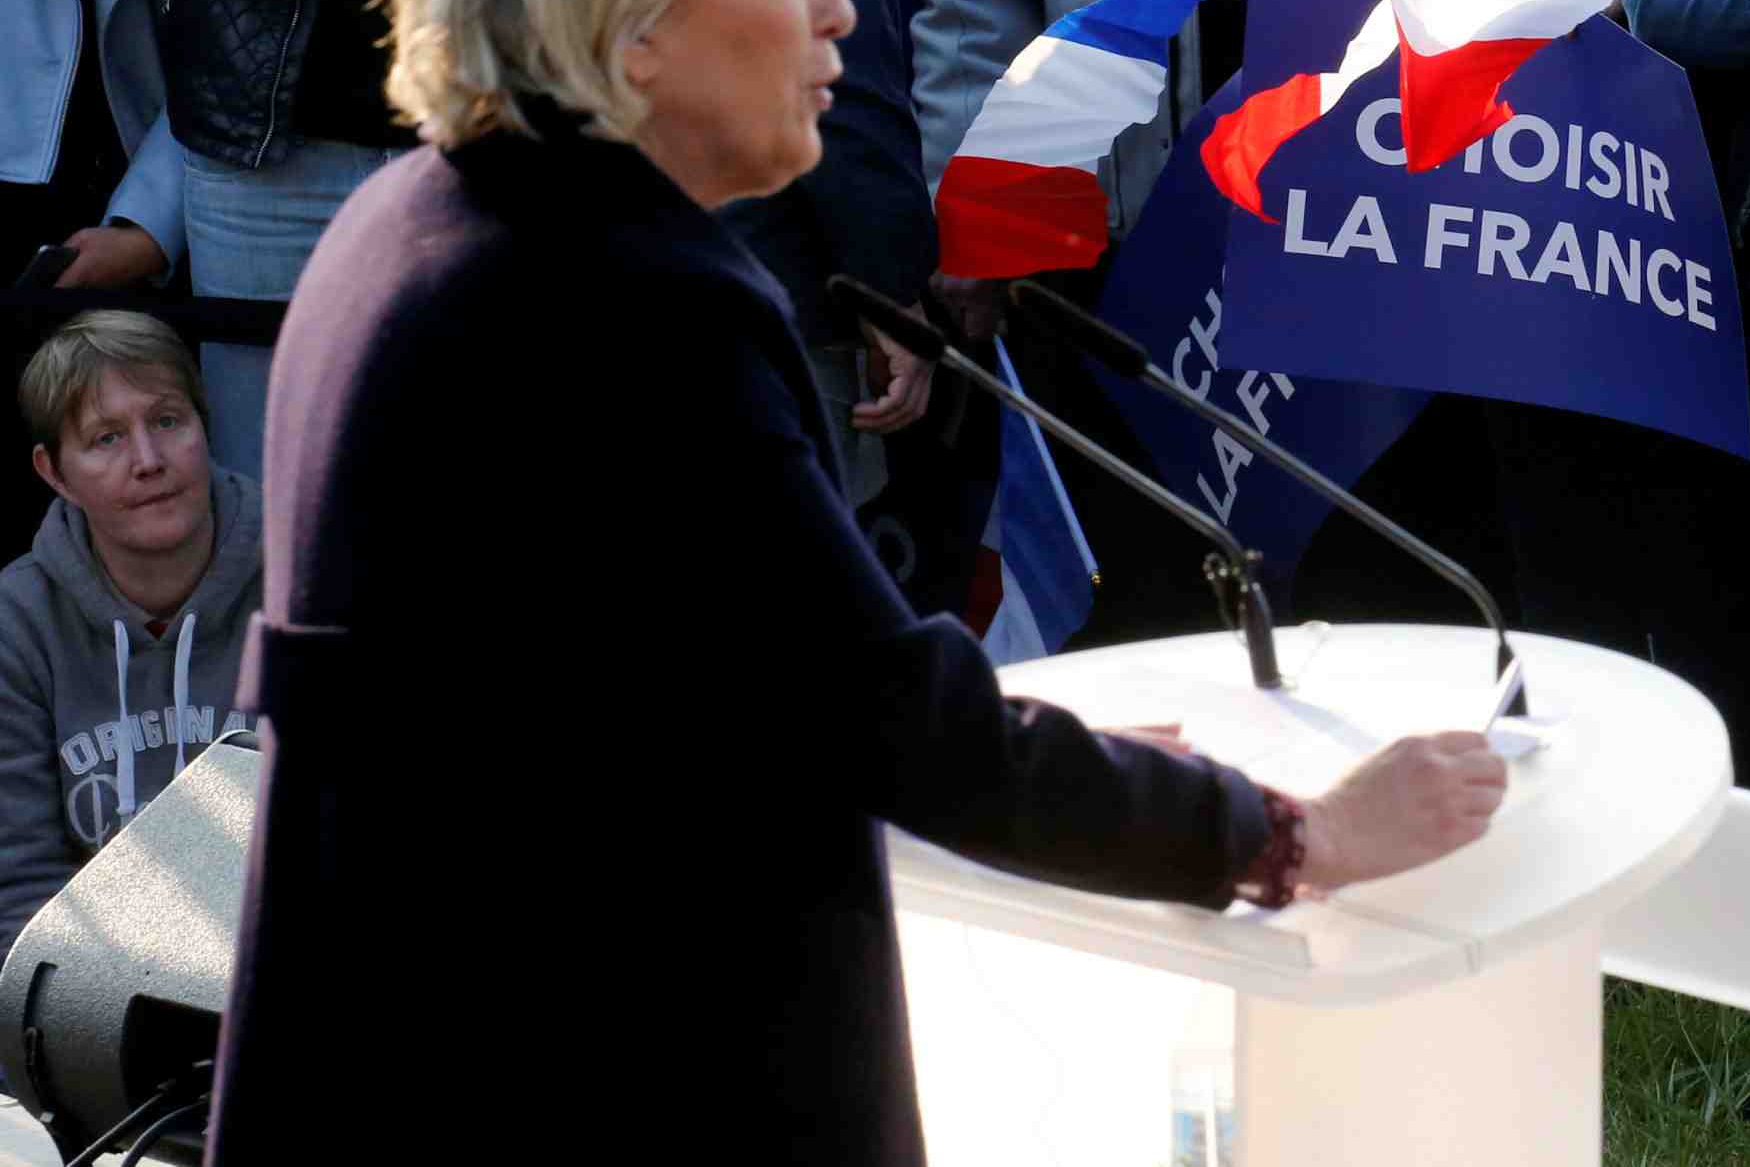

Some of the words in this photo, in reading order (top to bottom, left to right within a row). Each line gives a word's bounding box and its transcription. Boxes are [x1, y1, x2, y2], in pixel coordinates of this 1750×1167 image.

[1283, 187, 1399, 265] LA
[1423, 202, 1718, 332] FRANCE
[1196, 426, 1254, 527] LA
